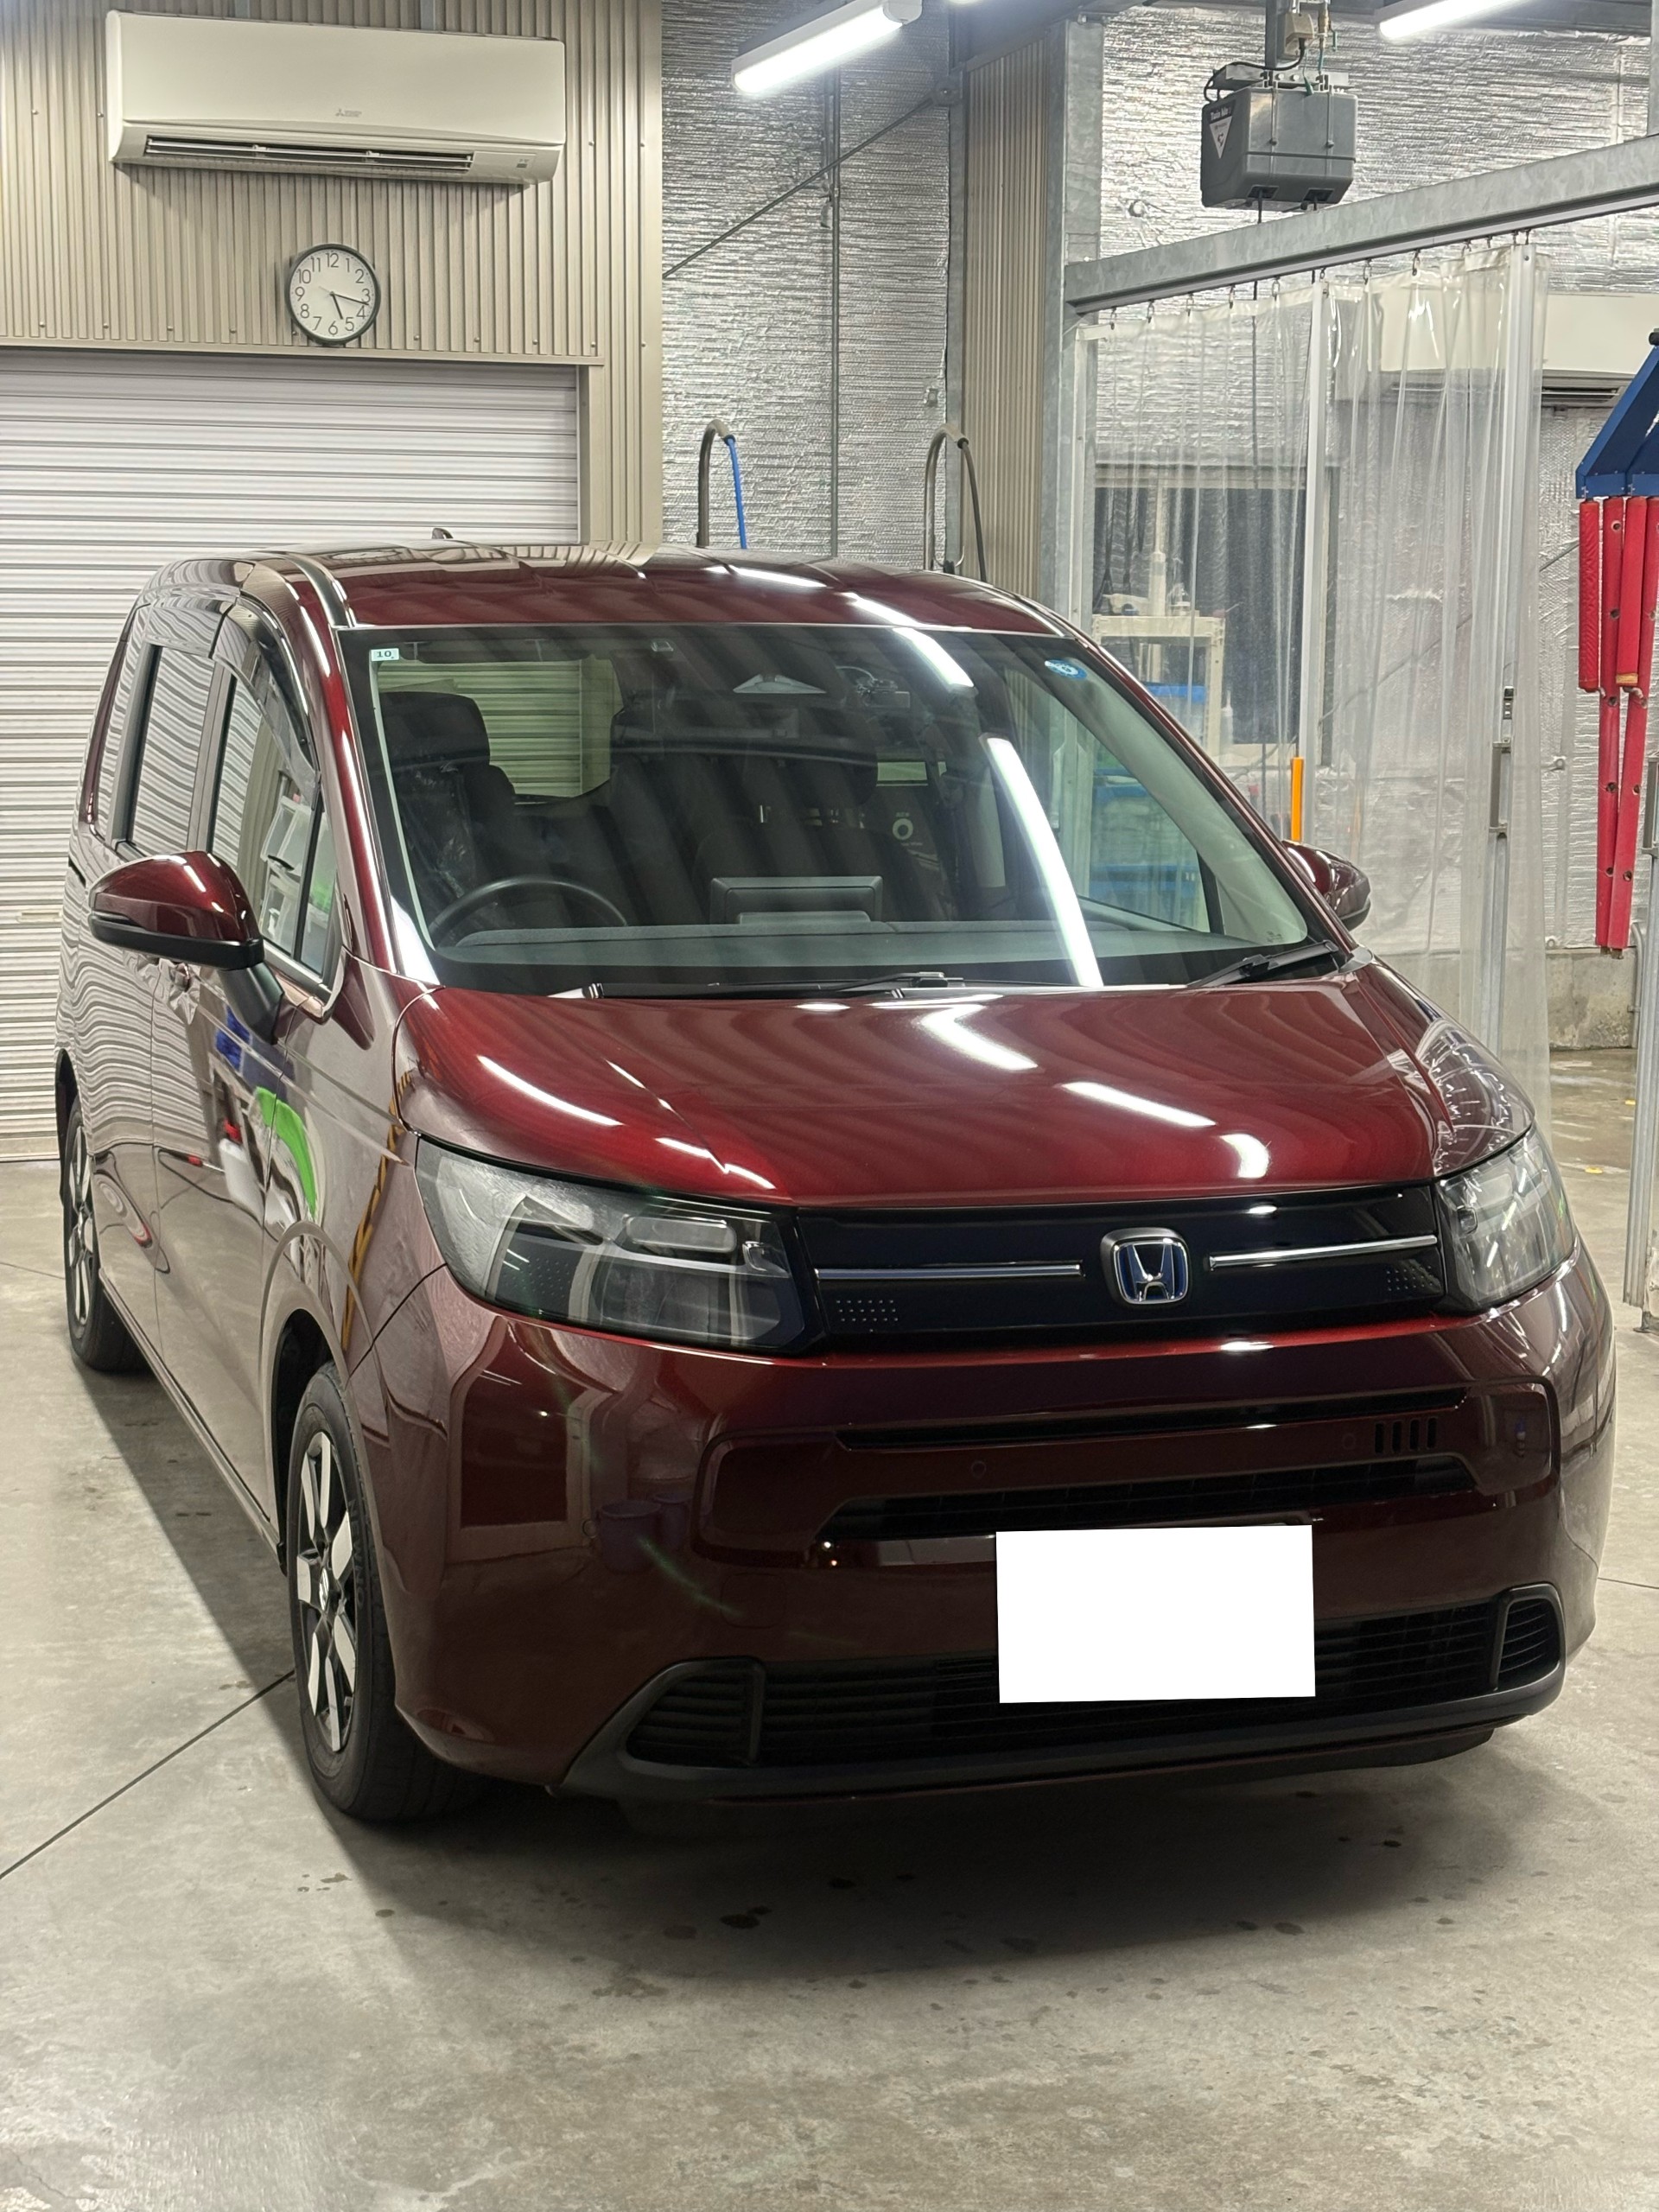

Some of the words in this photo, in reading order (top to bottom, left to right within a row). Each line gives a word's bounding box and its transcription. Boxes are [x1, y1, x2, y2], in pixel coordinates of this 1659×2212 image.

[311, 257, 321, 273] 11
[325, 253, 340, 268] 12
[345, 257, 350, 273] 1
[298, 269, 311, 284] 10
[354, 269, 365, 283] 2
[295, 286, 305, 302] 9
[361, 288, 371, 303] 3
[300, 303, 309, 319] 8
[356, 305, 366, 320] 4
[312, 316, 322, 331] 7
[327, 321, 339, 335] 6
[345, 316, 354, 332] 5
